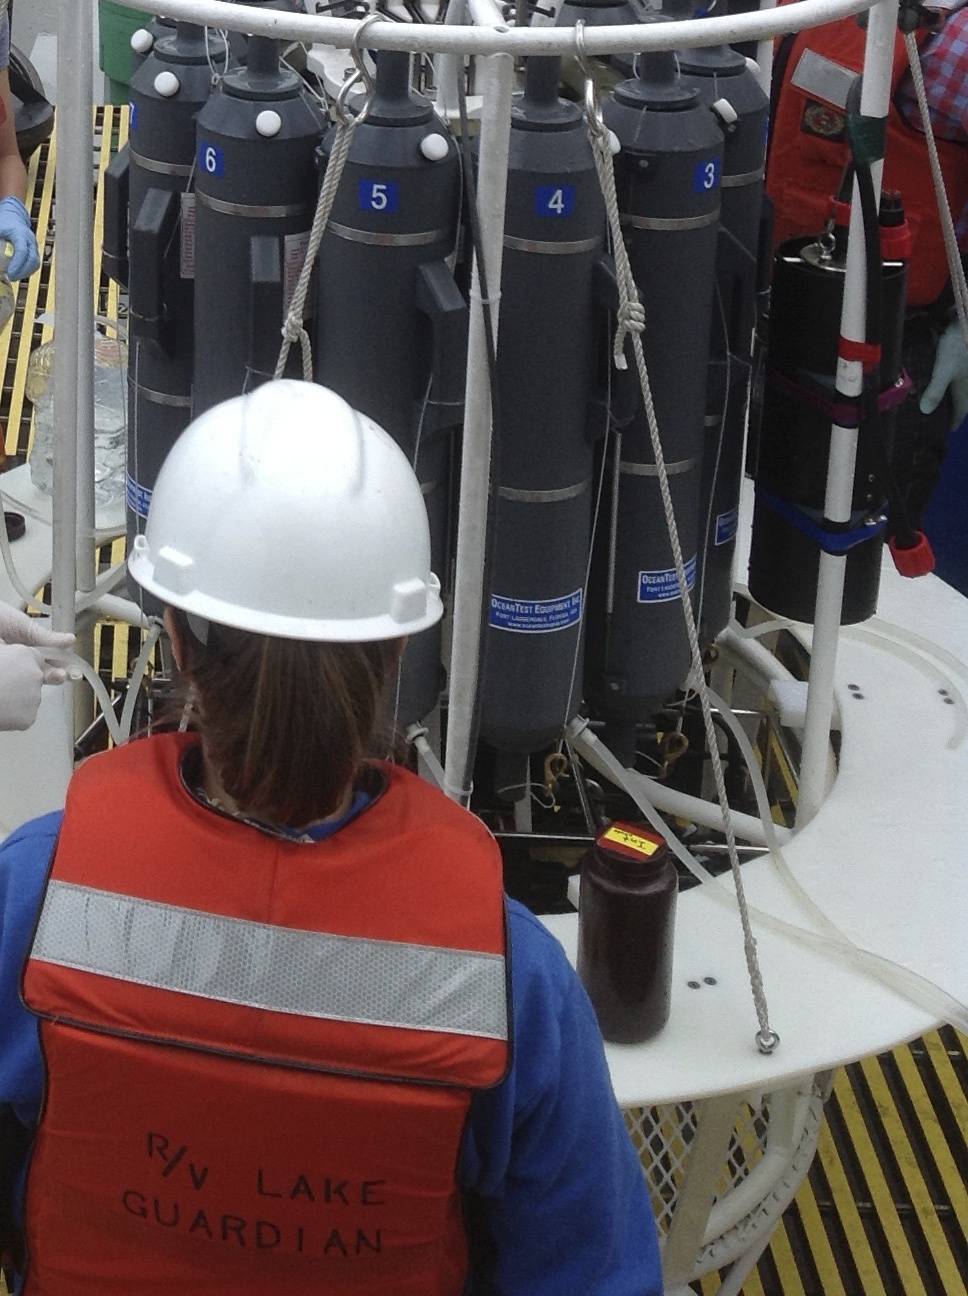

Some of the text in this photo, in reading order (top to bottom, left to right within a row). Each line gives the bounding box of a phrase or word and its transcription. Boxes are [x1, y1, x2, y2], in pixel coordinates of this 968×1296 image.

[205, 147, 217, 173] 6
[703, 162, 716, 190] 3
[370, 184, 388, 210] 5
[547, 189, 565, 215] 4
[147, 1130, 386, 1206] R/V LAKE
[122, 1190, 382, 1256] GUARDIAN
